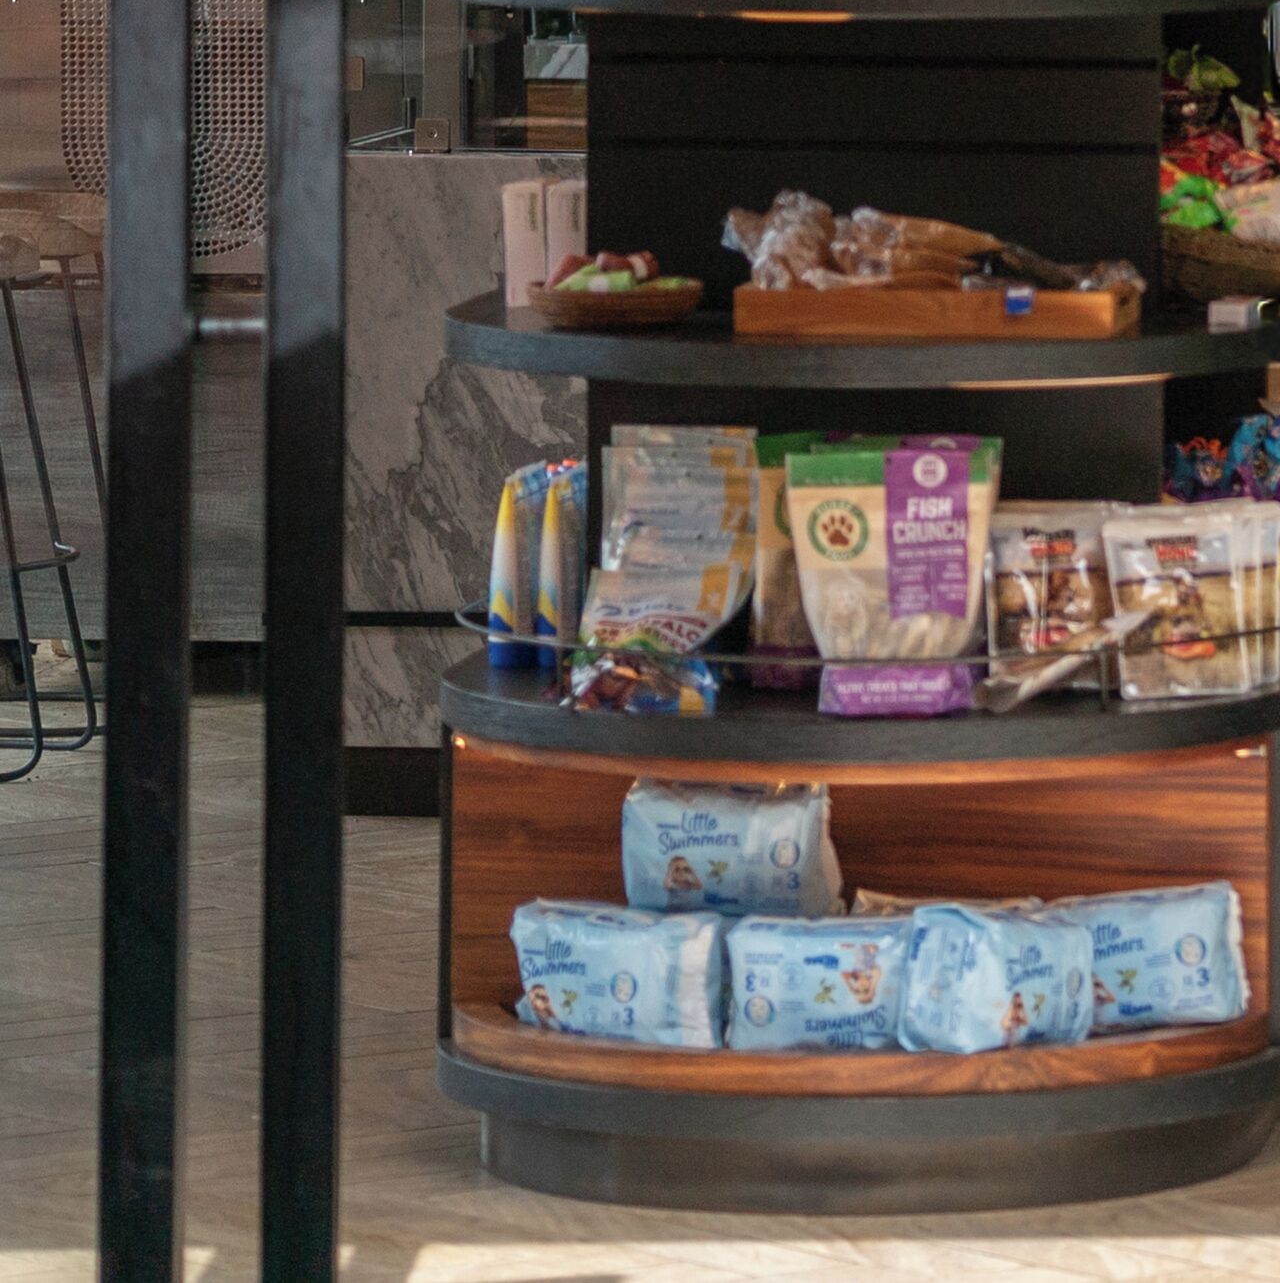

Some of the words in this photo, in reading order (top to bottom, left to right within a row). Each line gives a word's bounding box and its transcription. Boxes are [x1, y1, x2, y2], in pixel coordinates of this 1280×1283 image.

[907, 496, 953, 519] FISH
[893, 518, 967, 543] CRUNCH
[680, 812, 717, 832] Little
[658, 831, 739, 856] Swimmers
[788, 870, 800, 890] 3
[543, 938, 572, 960] Little
[1092, 936, 1144, 962] mmers
[521, 958, 587, 980] Swimmers
[1197, 967, 1210, 986] 3
